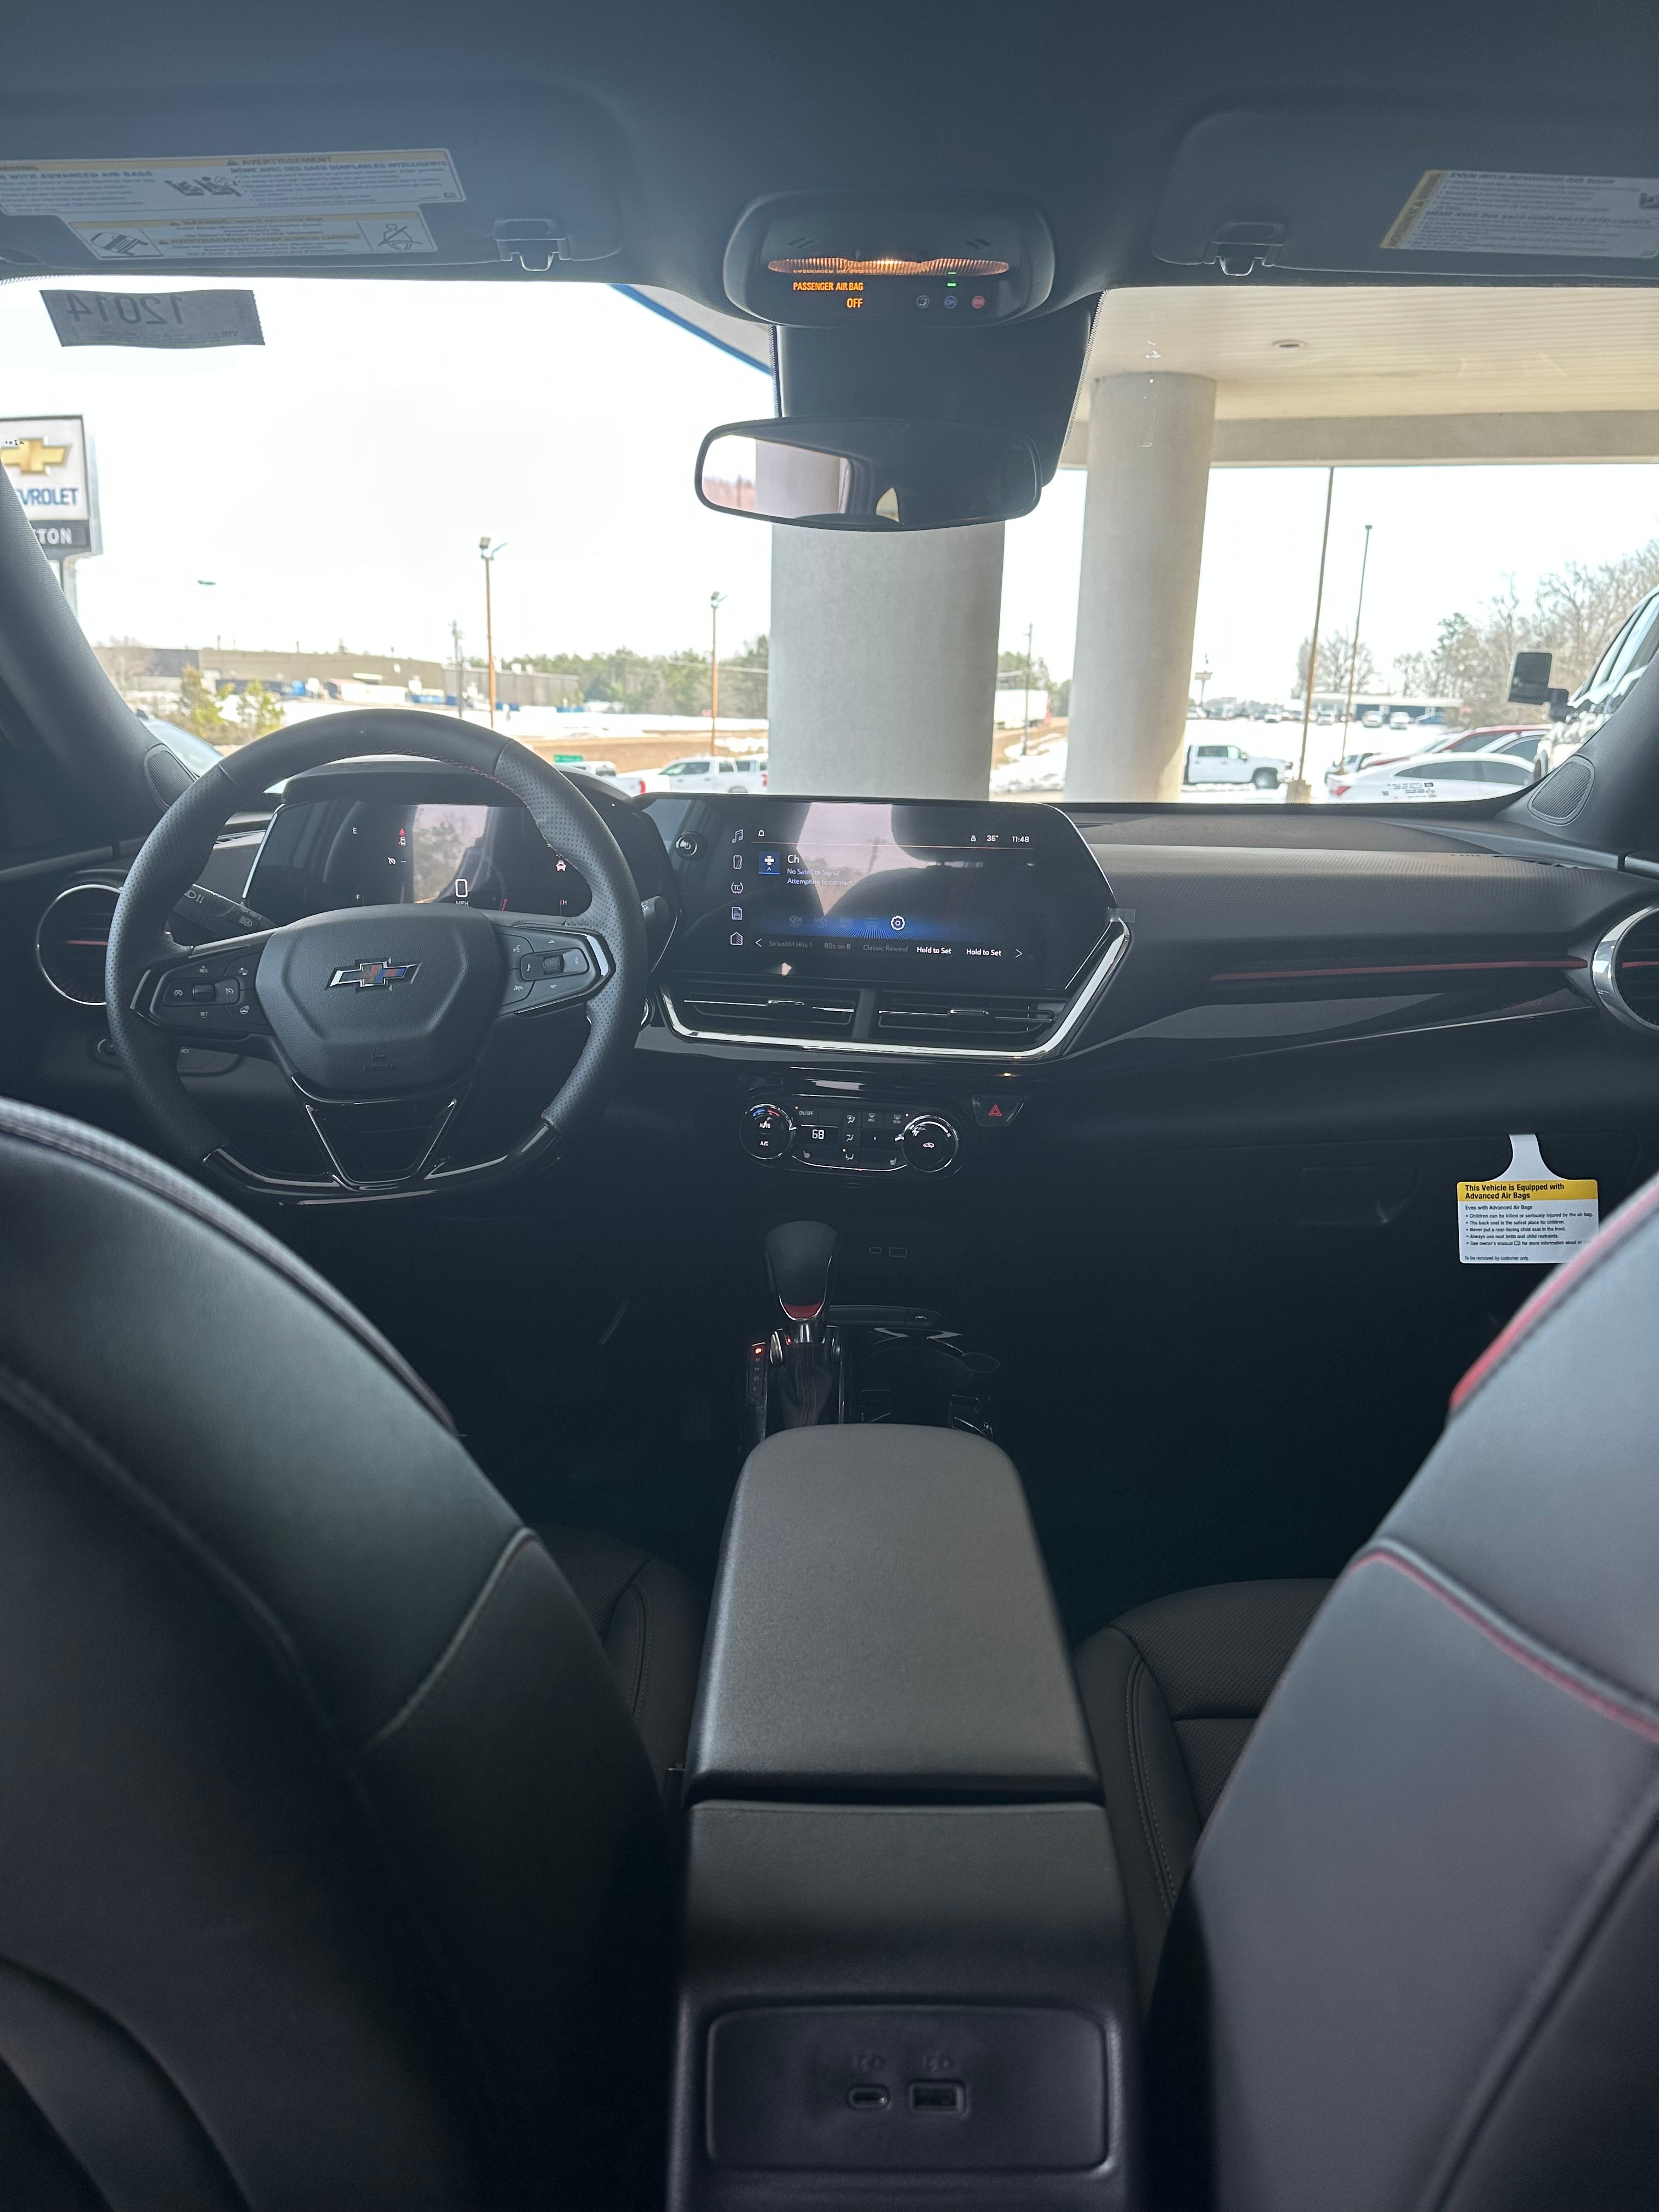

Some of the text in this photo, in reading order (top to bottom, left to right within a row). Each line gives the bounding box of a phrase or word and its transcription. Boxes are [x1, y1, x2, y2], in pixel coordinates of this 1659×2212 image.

[793, 282, 864, 291] PASSENGER AIR BAG
[847, 298, 863, 308] OFF
[15, 488, 78, 505] VROLET
[32, 528, 72, 544] TON
[787, 855, 799, 864] Ch
[787, 878, 820, 886] Attempting
[455, 879, 468, 898] 0
[812, 1129, 825, 1139] 68
[1517, 1183, 1548, 1192] Equipped
